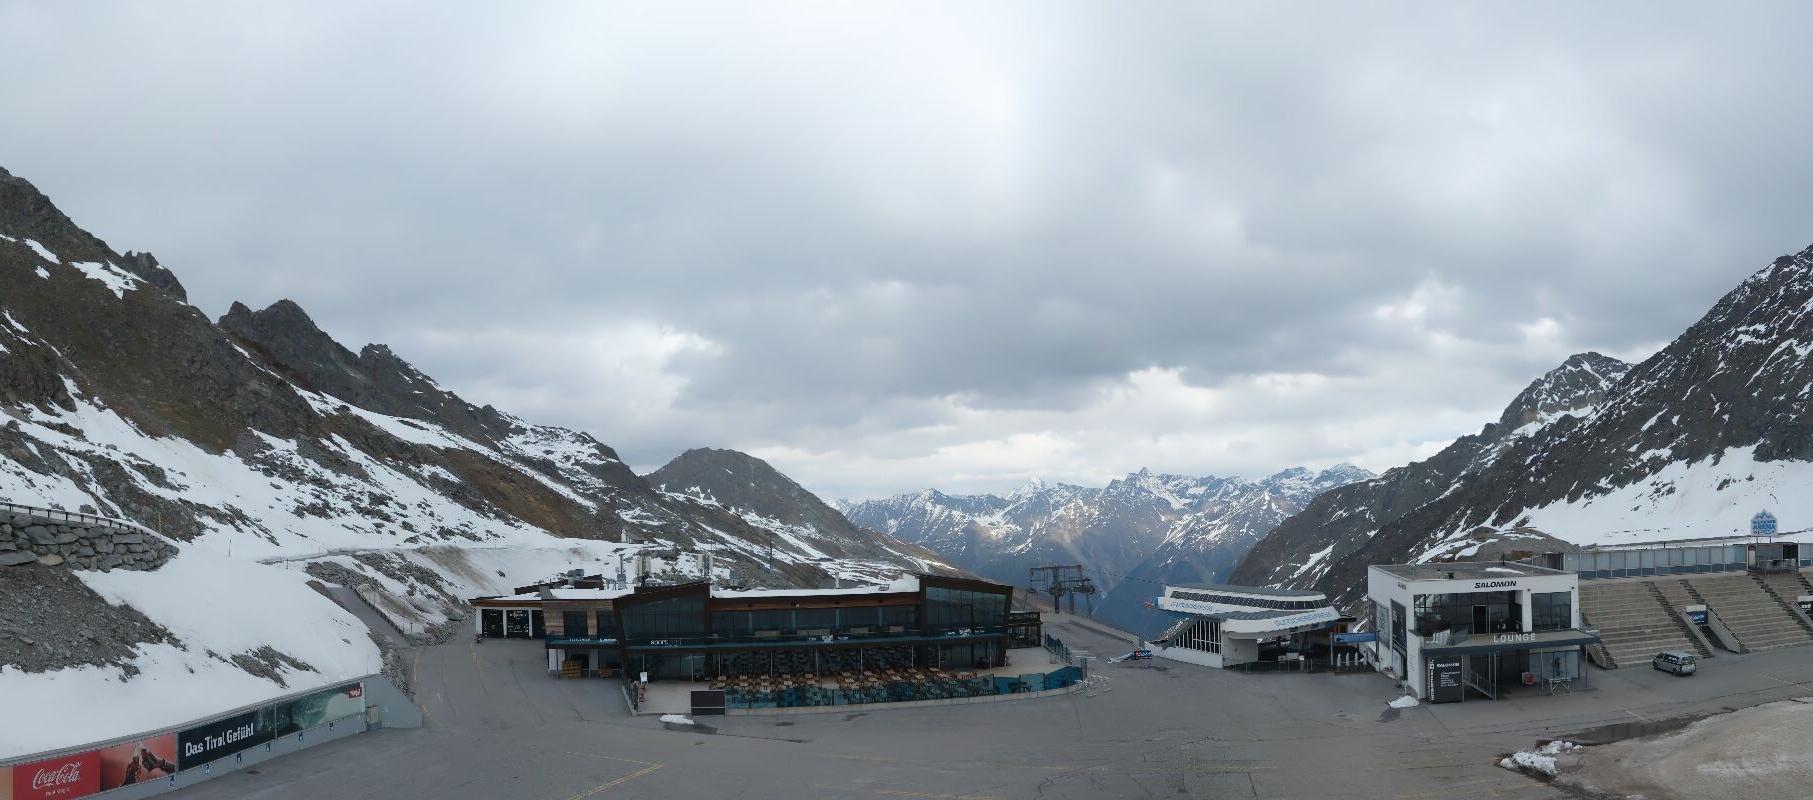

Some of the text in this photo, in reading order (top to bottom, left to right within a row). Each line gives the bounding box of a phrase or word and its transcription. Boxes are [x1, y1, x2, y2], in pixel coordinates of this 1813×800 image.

[1475, 581, 1517, 589] SALOMON
[1493, 633, 1536, 643] LOUNGE
[185, 722, 254, 757] Das Tirol Gefühl
